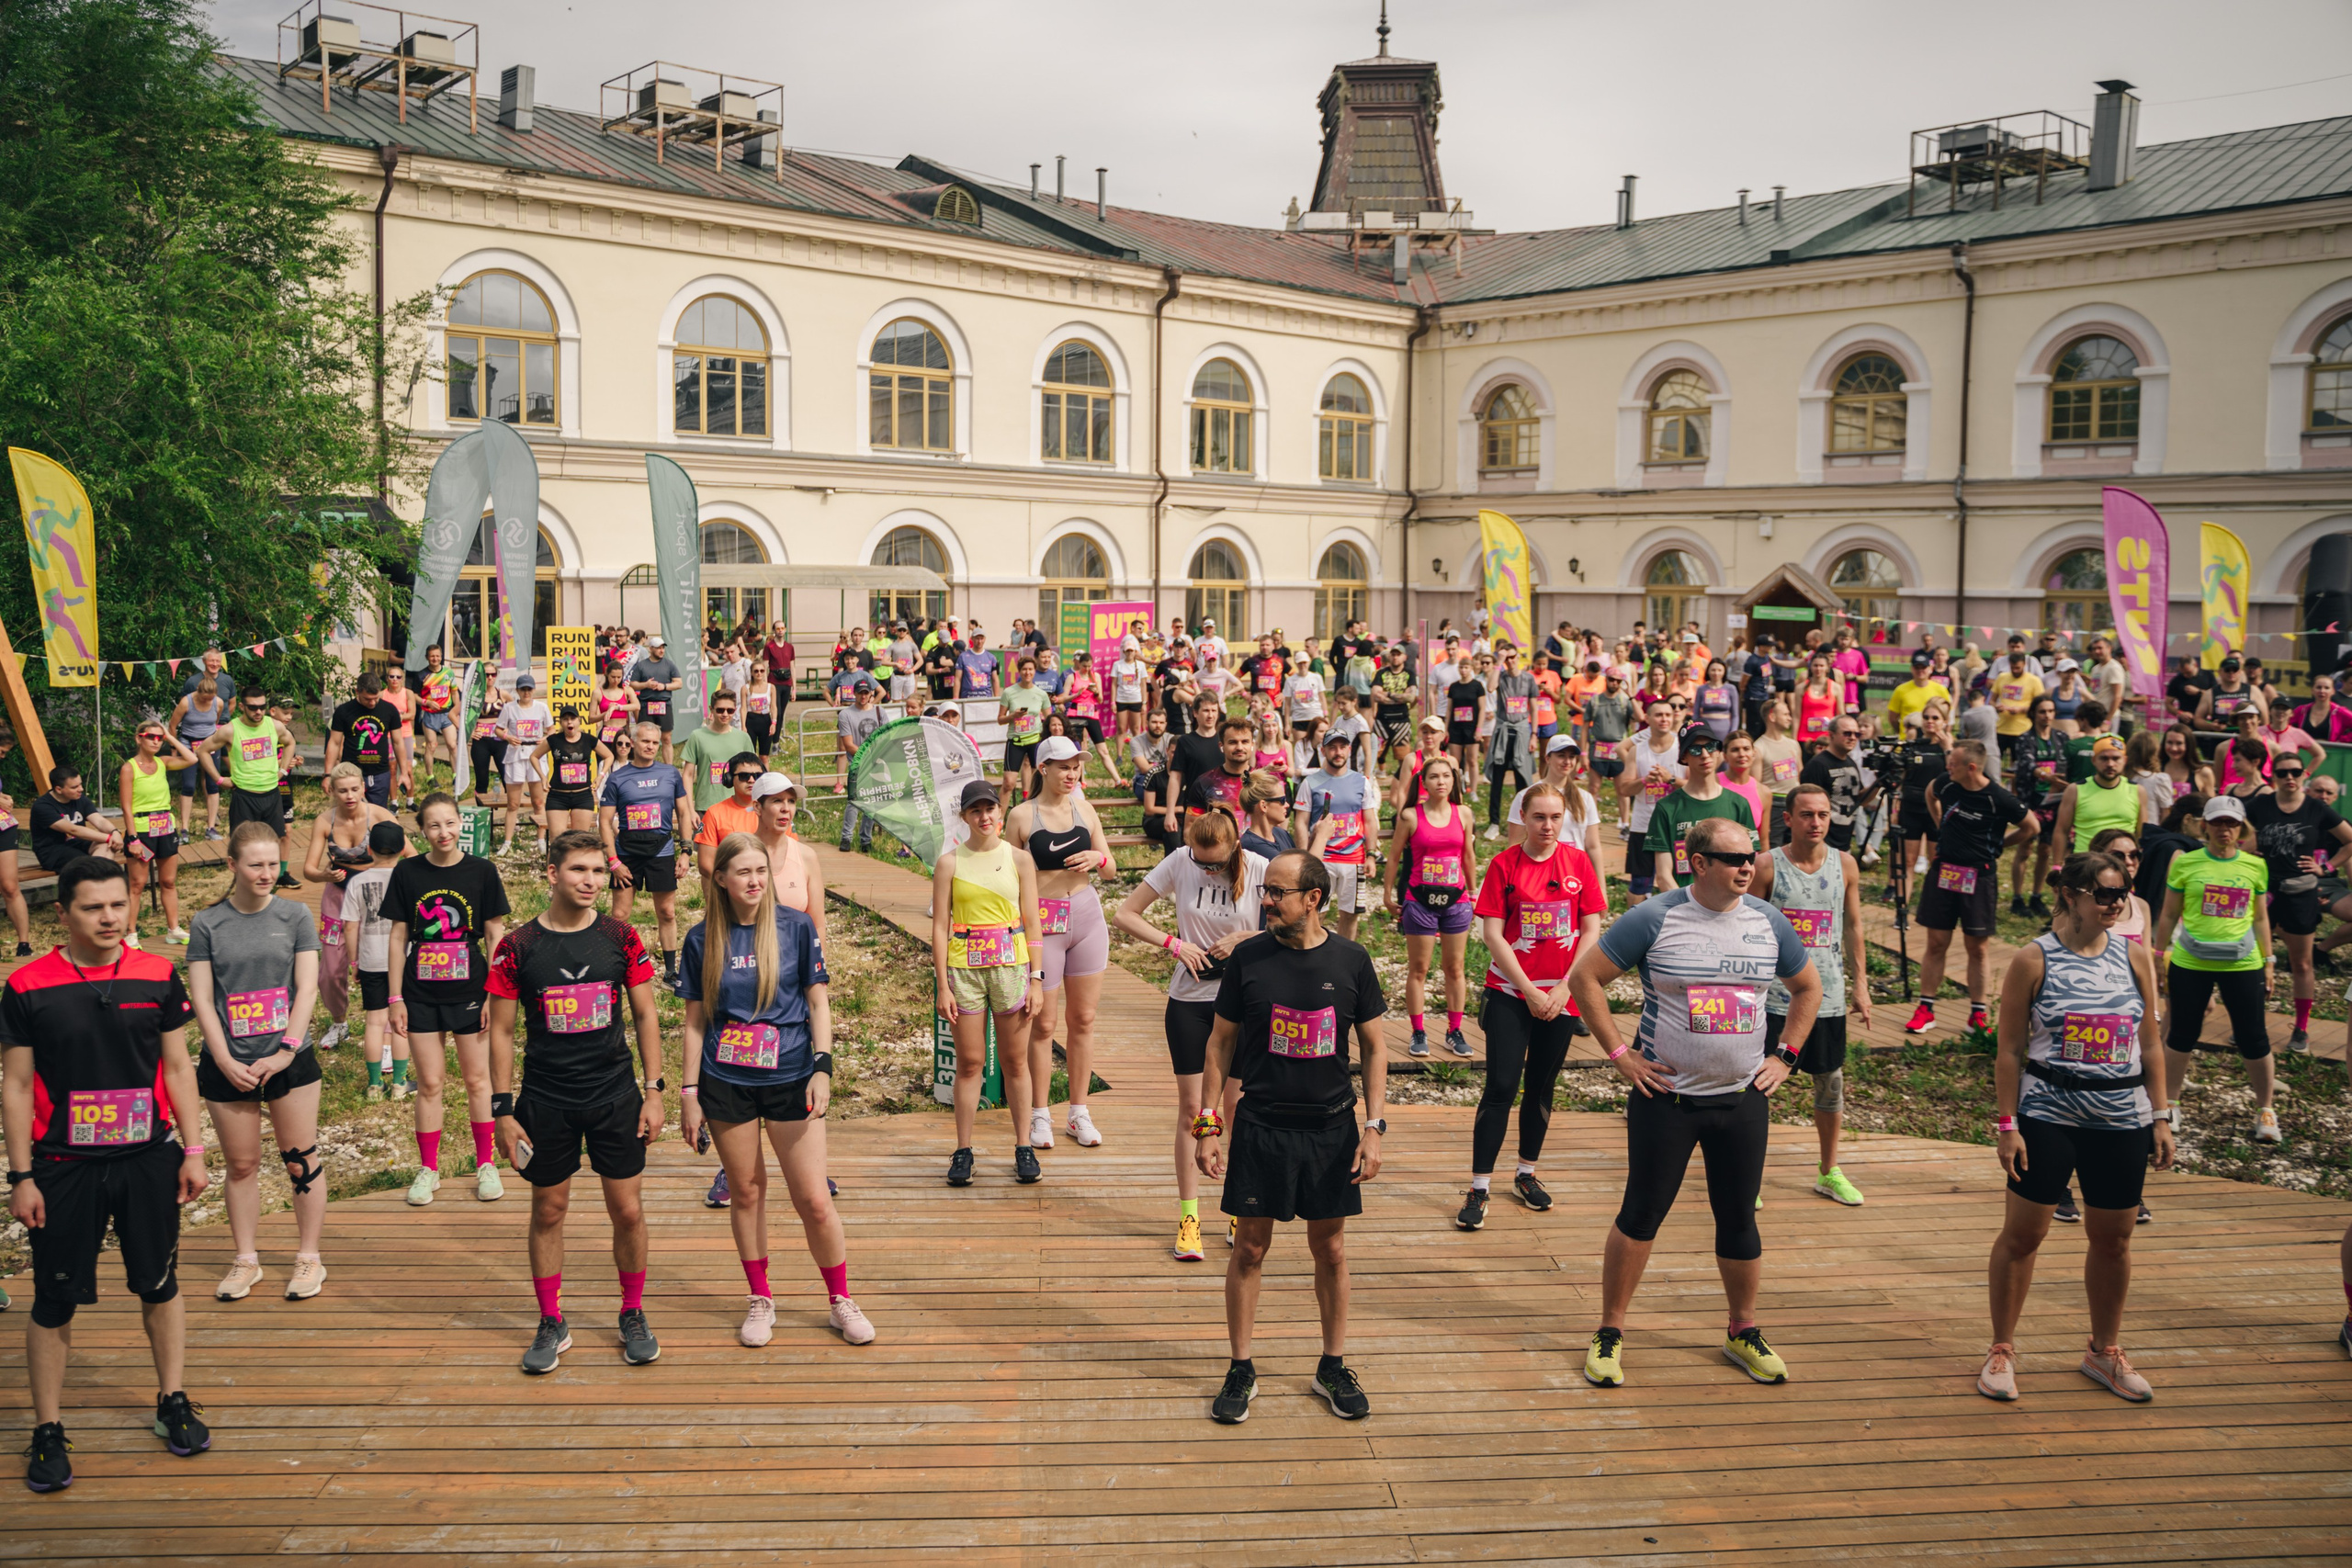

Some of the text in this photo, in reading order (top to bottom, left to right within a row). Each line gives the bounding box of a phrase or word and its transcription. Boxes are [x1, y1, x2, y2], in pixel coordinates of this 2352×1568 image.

[1094, 612, 1149, 640] RUTS
[551, 633, 590, 643] RUN
[551, 647, 590, 657] RUN
[552, 688, 591, 698] RUN
[243, 743, 262, 752] 058
[628, 810, 648, 820] 299
[150, 819, 167, 828] 057
[1423, 863, 1443, 874] 218
[421, 888, 448, 901] URBAN
[449, 890, 468, 907] TRAIL
[1428, 893, 1449, 905] 843
[2205, 892, 2229, 905] 178
[1521, 911, 1553, 924] 369
[968, 938, 997, 952] 324
[419, 952, 449, 965] 220
[1720, 959, 1758, 976] RUN
[229, 1002, 266, 1021] 102
[546, 998, 578, 1014] 119
[1690, 998, 1725, 1015] 241
[1272, 1018, 1308, 1040] 051
[2064, 1025, 2109, 1044] 240
[720, 1028, 754, 1048] 223
[71, 1104, 118, 1123] 105
